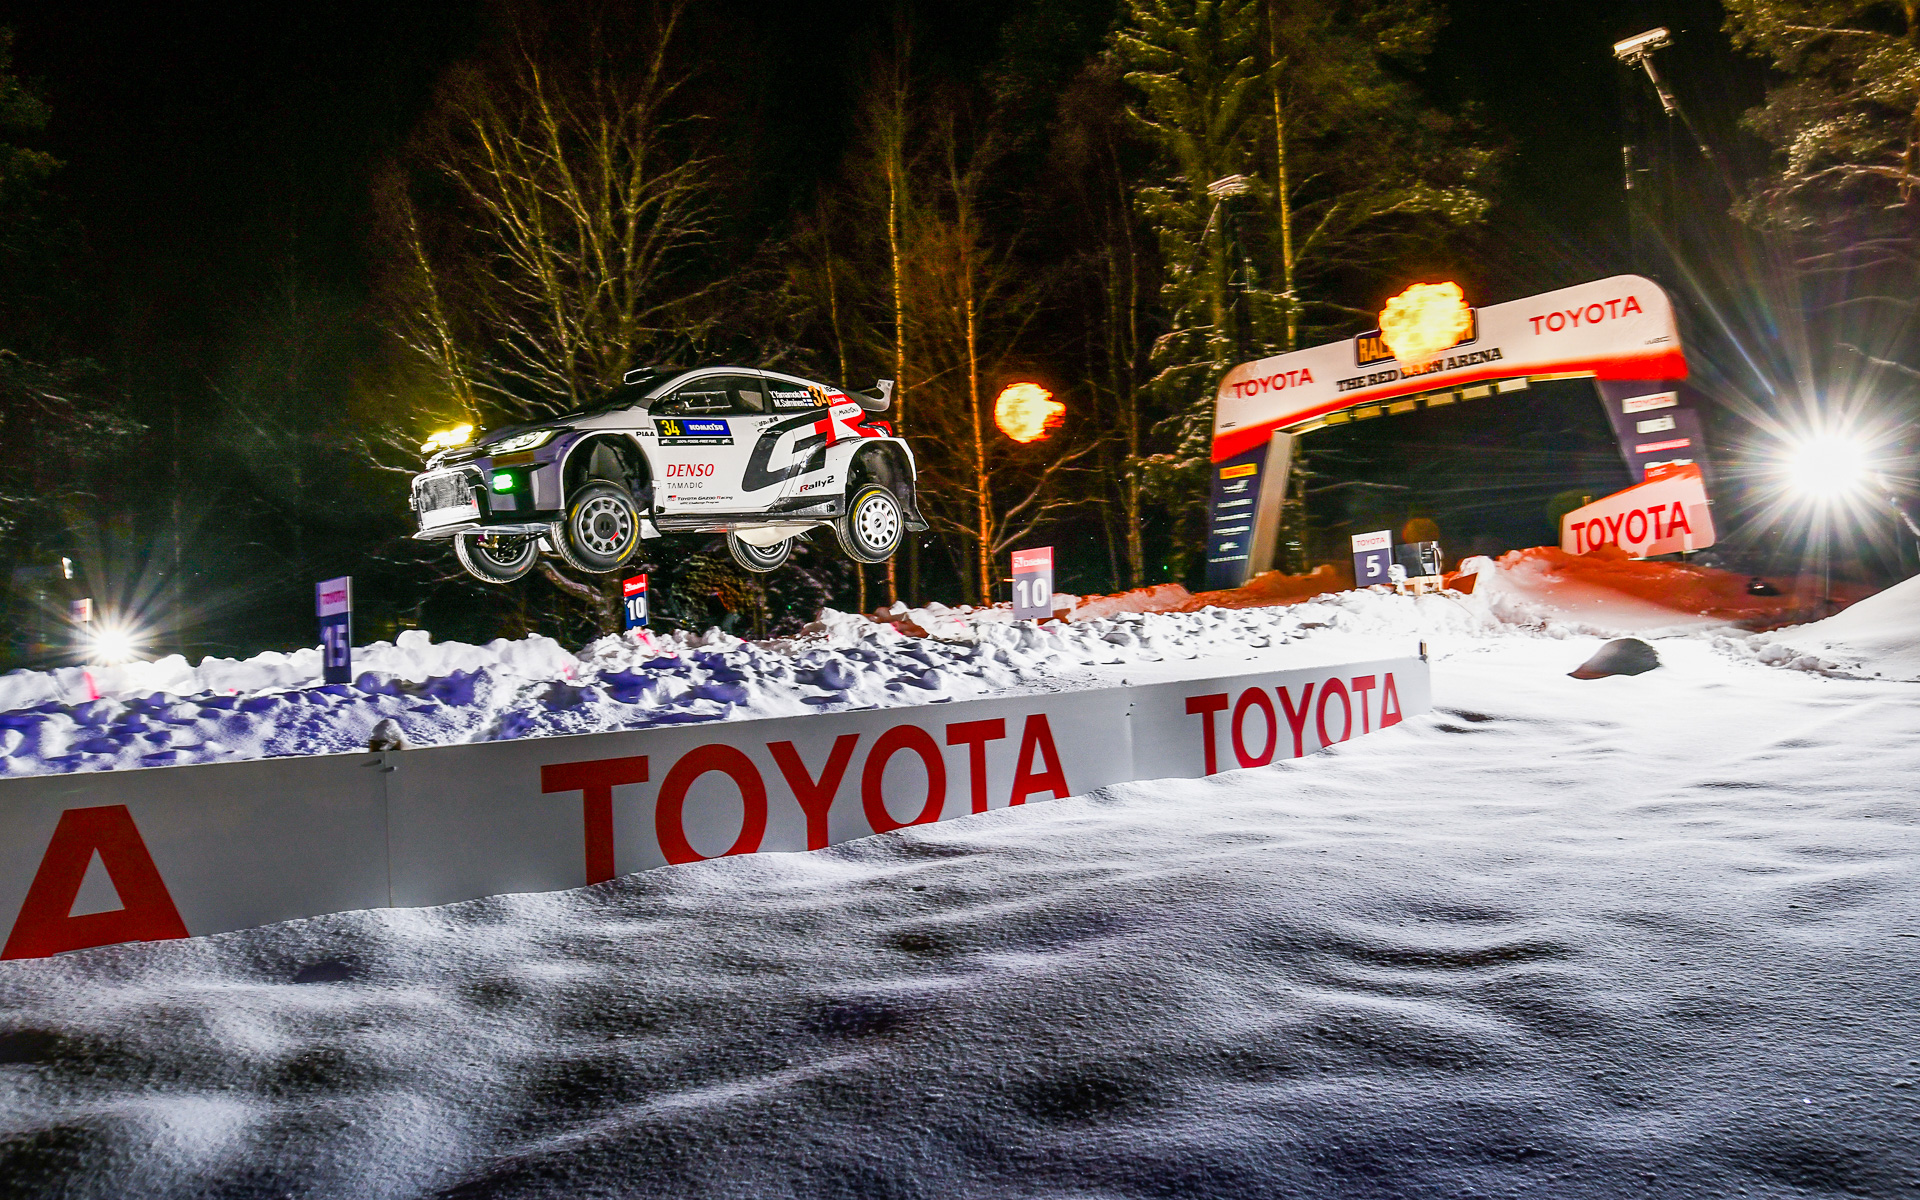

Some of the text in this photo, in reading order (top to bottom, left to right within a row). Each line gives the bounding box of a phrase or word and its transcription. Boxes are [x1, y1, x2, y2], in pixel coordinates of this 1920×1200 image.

[1529, 296, 1643, 335] TOYOTA
[1336, 347, 1503, 392] THE RED BARN ARENA
[1232, 367, 1314, 399] TOYOTA
[807, 385, 832, 407] 34
[1629, 396, 1673, 408] TOYOTA
[661, 419, 725, 436] 34 KOMATSU
[666, 463, 715, 477] DENSO
[667, 481, 704, 489] TAMADIC
[800, 475, 835, 492] Rally2
[1571, 501, 1692, 554] TOYOTA
[1356, 537, 1385, 546] TOYOTA
[1366, 554, 1382, 578] 5
[1016, 578, 1048, 609] 10
[627, 596, 646, 621] 10
[321, 624, 347, 667] 15
[1185, 672, 1403, 776] TOYOTA
[540, 713, 1071, 886] TOYOTA
